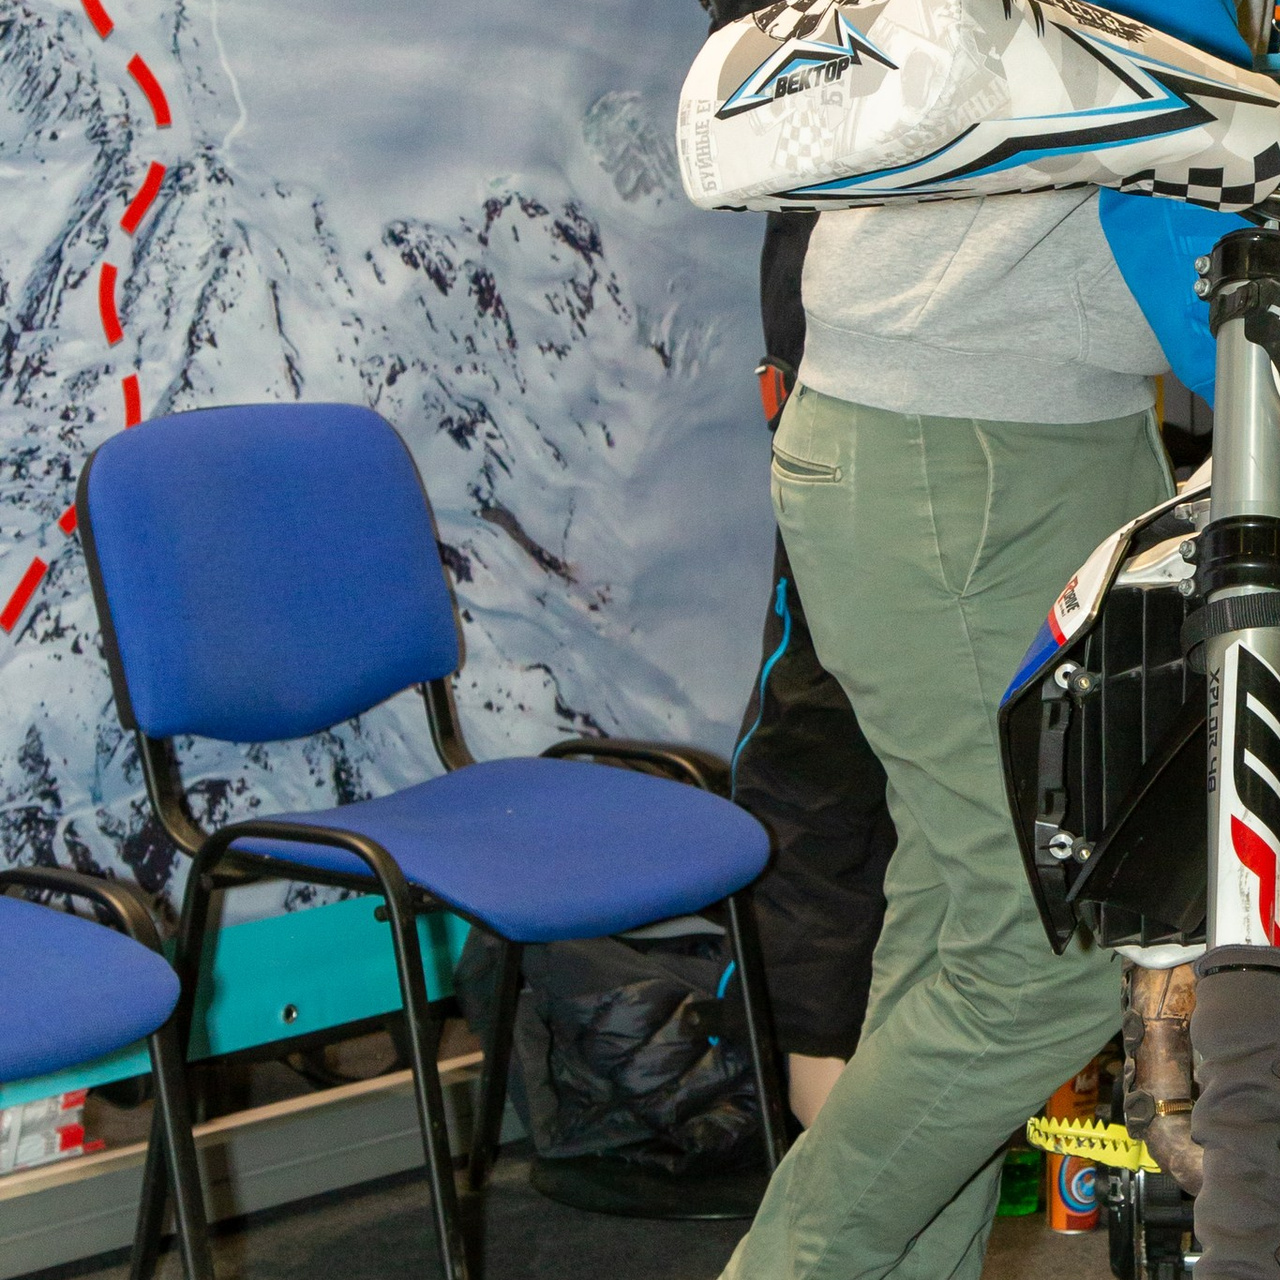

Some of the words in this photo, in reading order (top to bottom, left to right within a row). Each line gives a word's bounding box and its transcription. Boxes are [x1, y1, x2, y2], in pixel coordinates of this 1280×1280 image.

[773, 56, 851, 100] ВЕКТОР
[1209, 667, 1220, 752] XPLOR
[1207, 762, 1217, 793] 48
